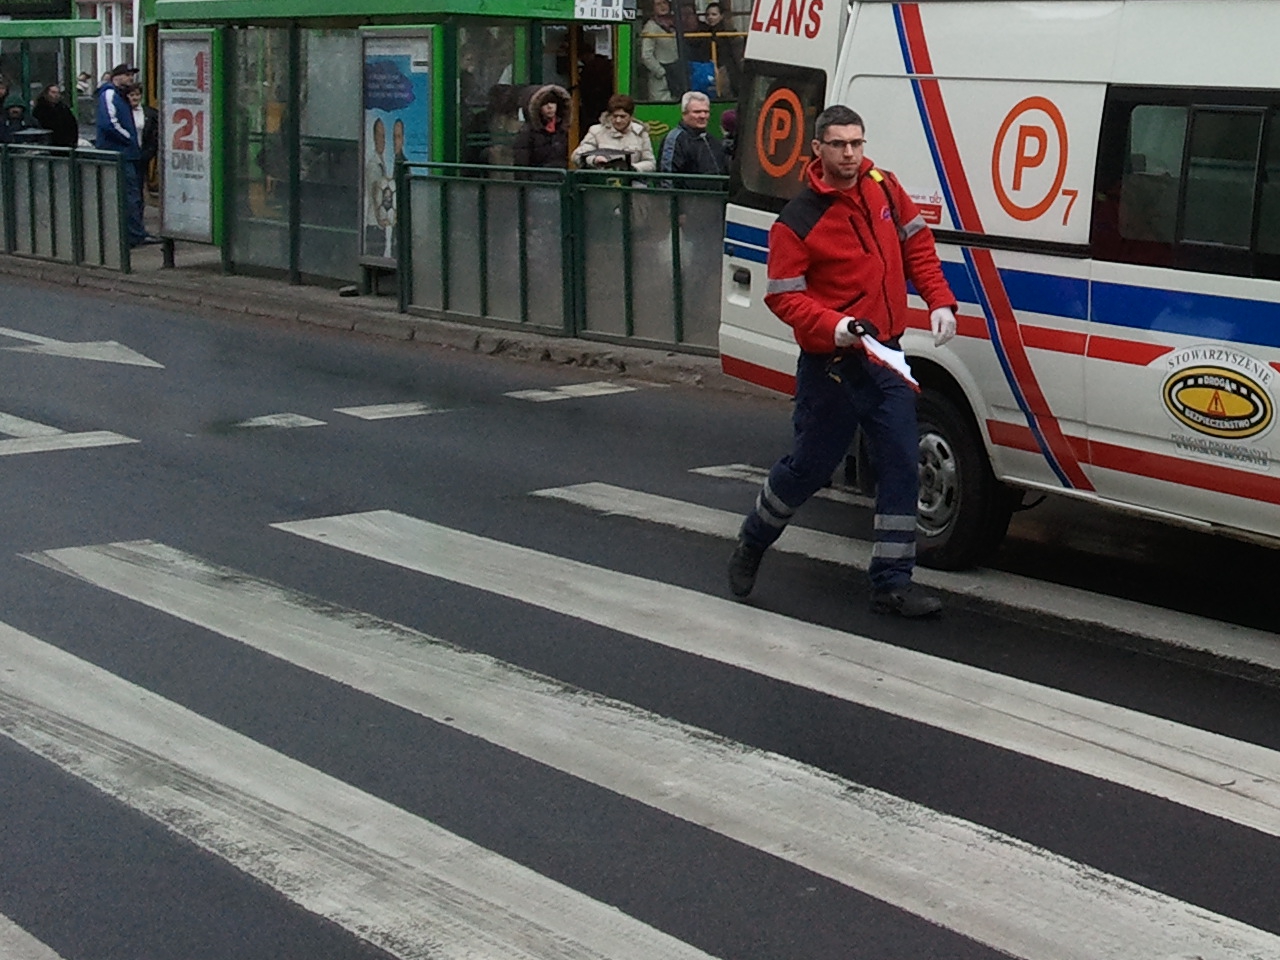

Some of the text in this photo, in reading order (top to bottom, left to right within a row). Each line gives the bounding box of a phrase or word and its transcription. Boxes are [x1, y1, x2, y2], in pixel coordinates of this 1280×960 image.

[172, 108, 205, 152] 21
[1061, 188, 1079, 227] 7
[1168, 348, 1272, 386] STOWARZYSZENIE
